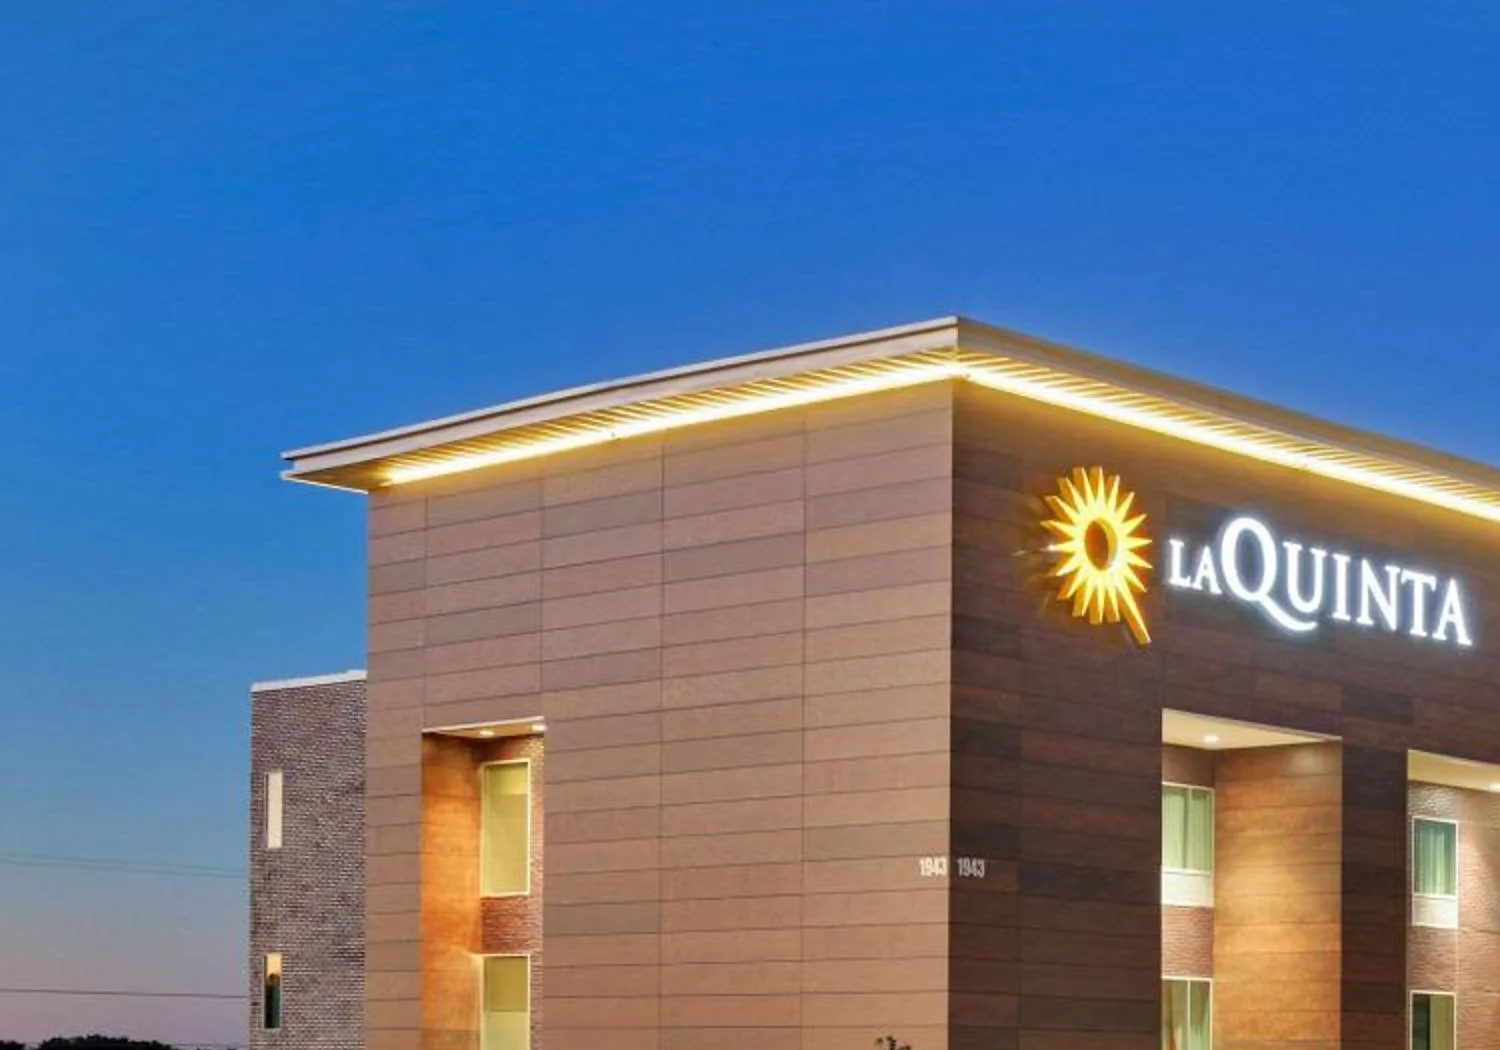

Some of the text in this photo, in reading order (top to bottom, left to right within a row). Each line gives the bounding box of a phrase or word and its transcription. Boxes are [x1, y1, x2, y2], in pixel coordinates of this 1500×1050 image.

[1168, 516, 1473, 646] LA QUINTA
[919, 856, 948, 877] 1943
[957, 856, 985, 878] 1943
